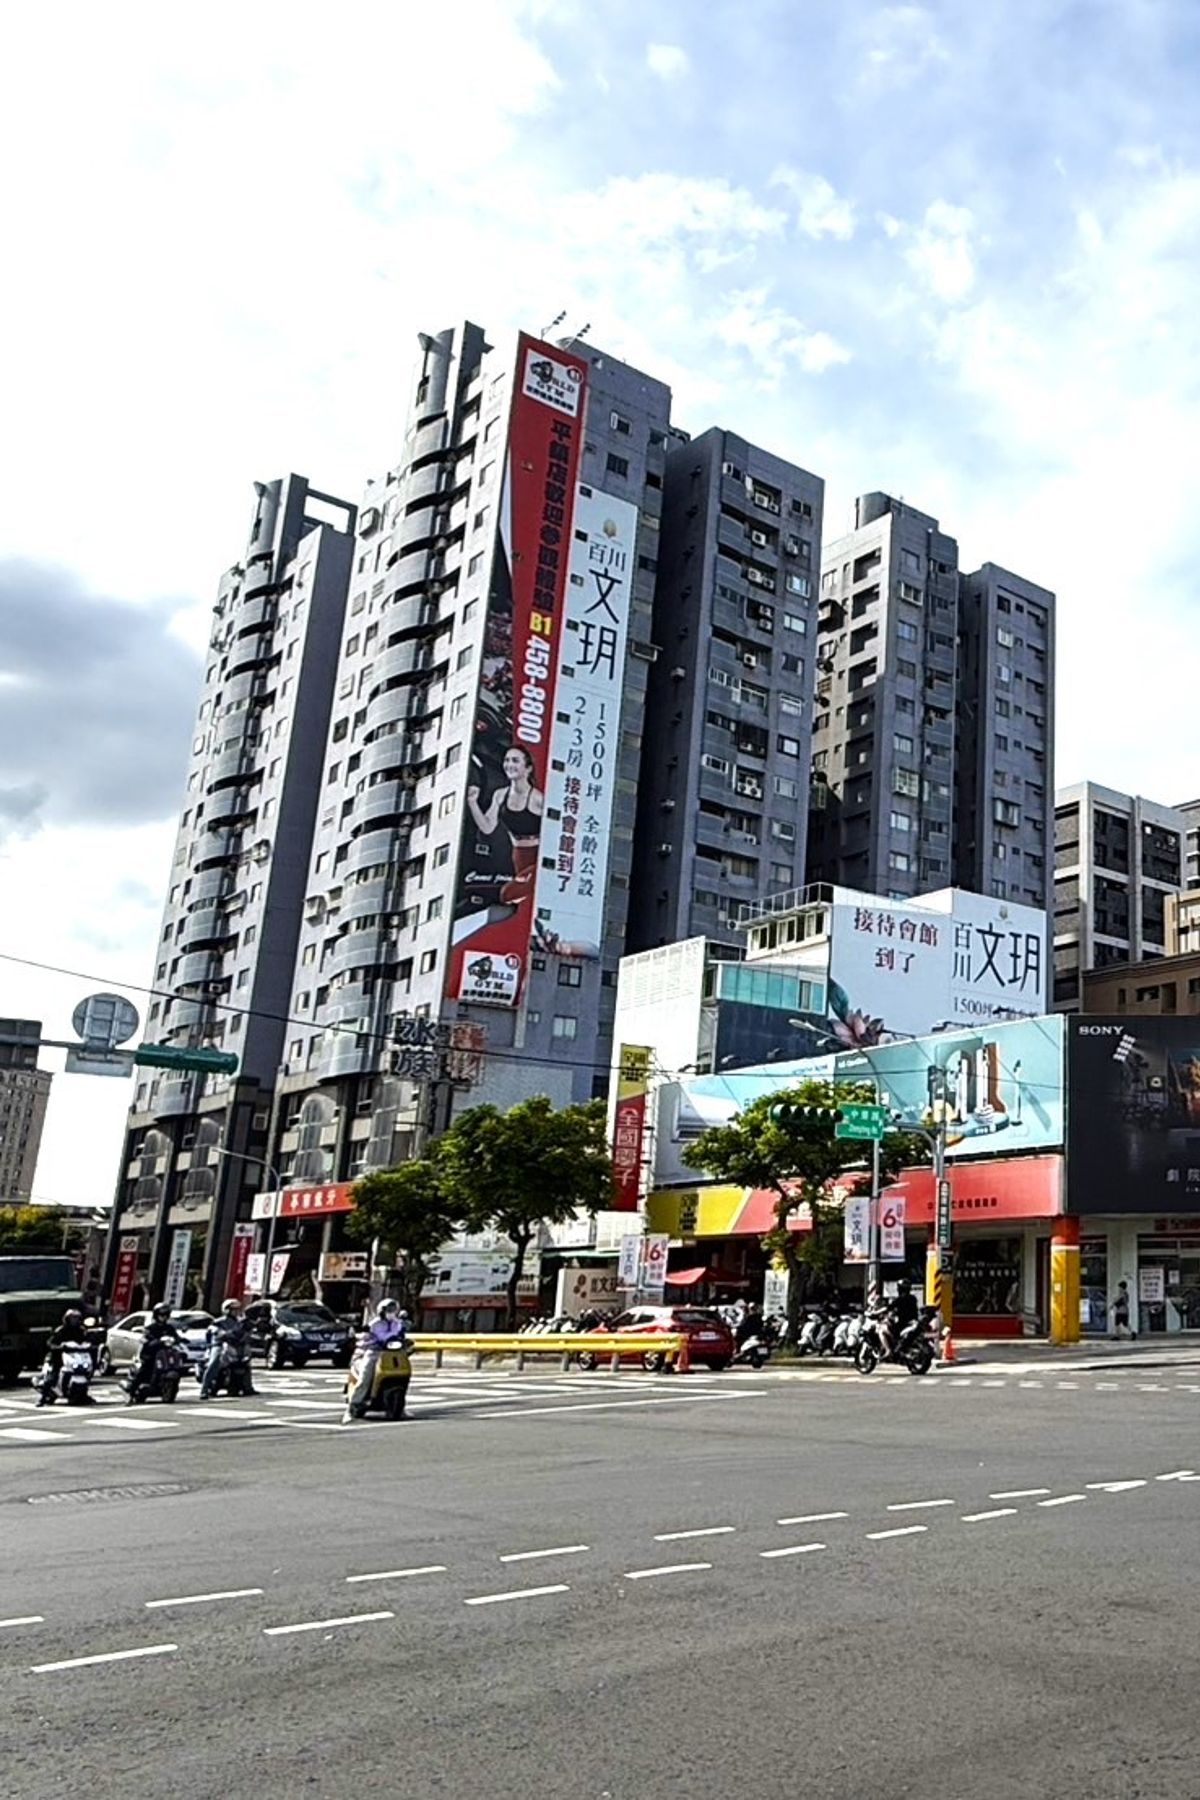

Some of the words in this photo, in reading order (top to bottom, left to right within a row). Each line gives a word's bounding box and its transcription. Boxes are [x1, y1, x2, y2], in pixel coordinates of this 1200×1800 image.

[588, 542, 627, 572] 百川
[529, 611, 552, 635] B1
[517, 634, 550, 743] 458-8800
[854, 907, 939, 948] 接待會館
[875, 946, 916, 974] 到了
[952, 922, 973, 982] 百川
[394, 1015, 439, 1078] 水族
[1079, 1025, 1124, 1036] SONY
